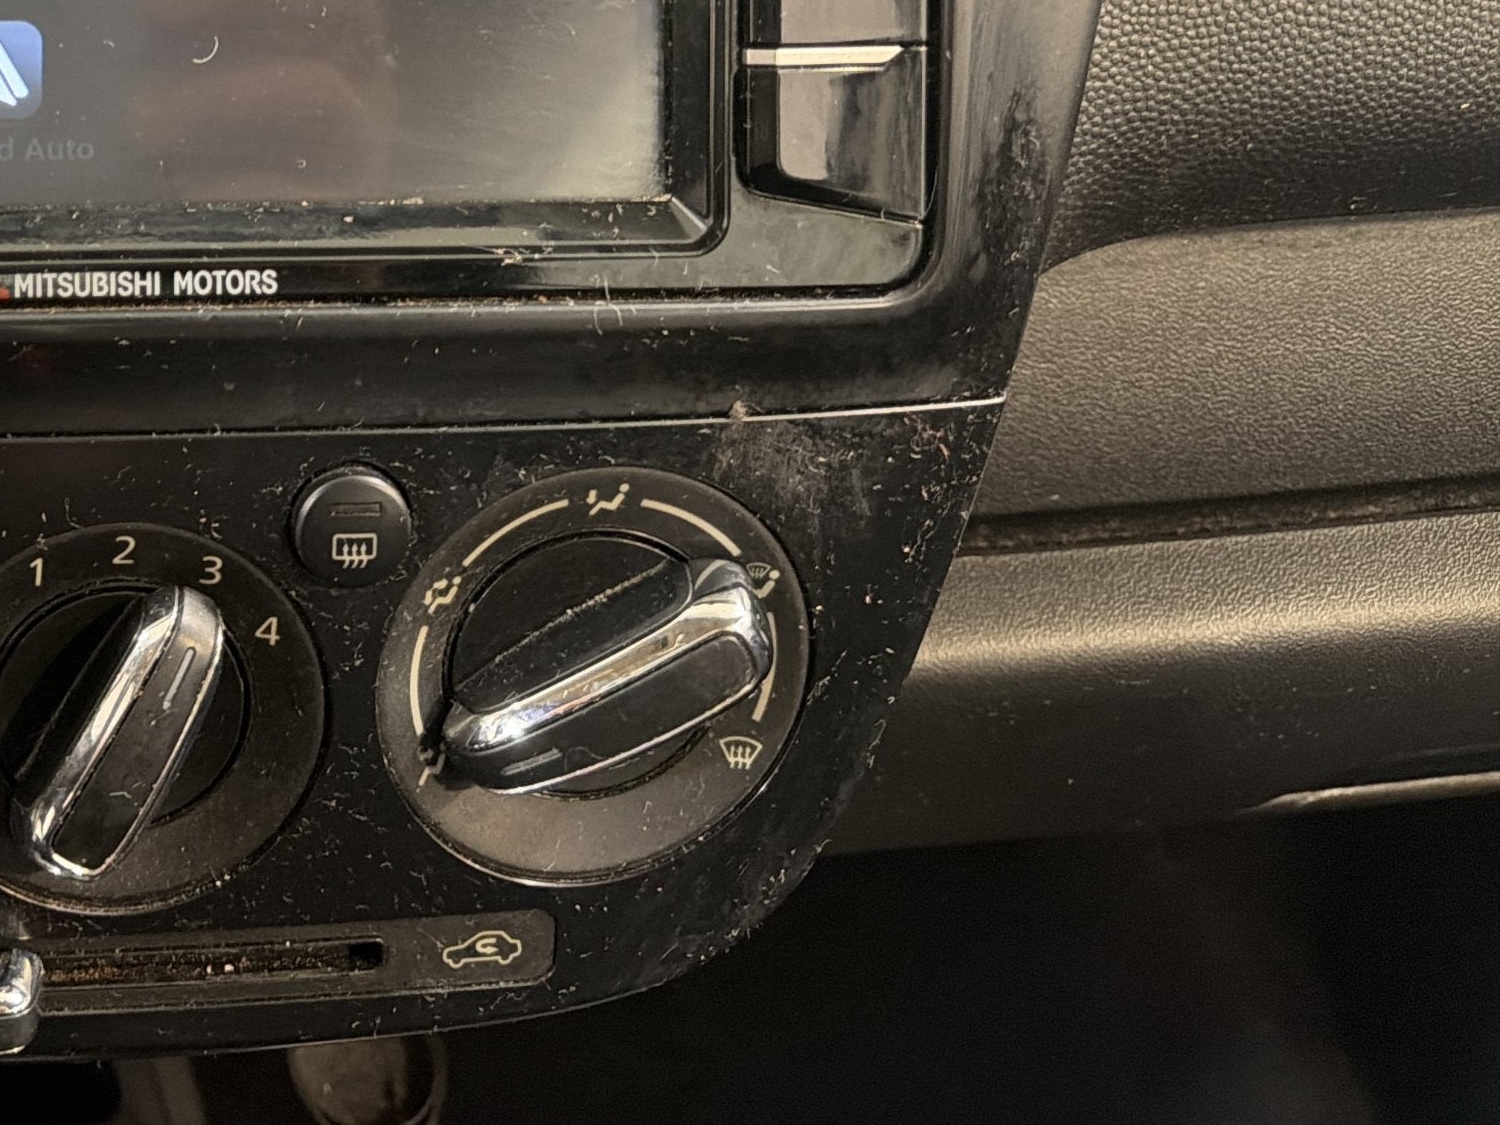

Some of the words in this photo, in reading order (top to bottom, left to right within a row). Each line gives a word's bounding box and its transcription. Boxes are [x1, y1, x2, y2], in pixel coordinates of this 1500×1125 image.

[24, 138, 95, 163] Auto
[14, 271, 160, 299] MITSUBISHI
[173, 269, 279, 295] MOTORS
[111, 536, 136, 564] 2
[29, 558, 44, 586] 1
[201, 556, 223, 584] 3
[254, 617, 280, 646] 4
